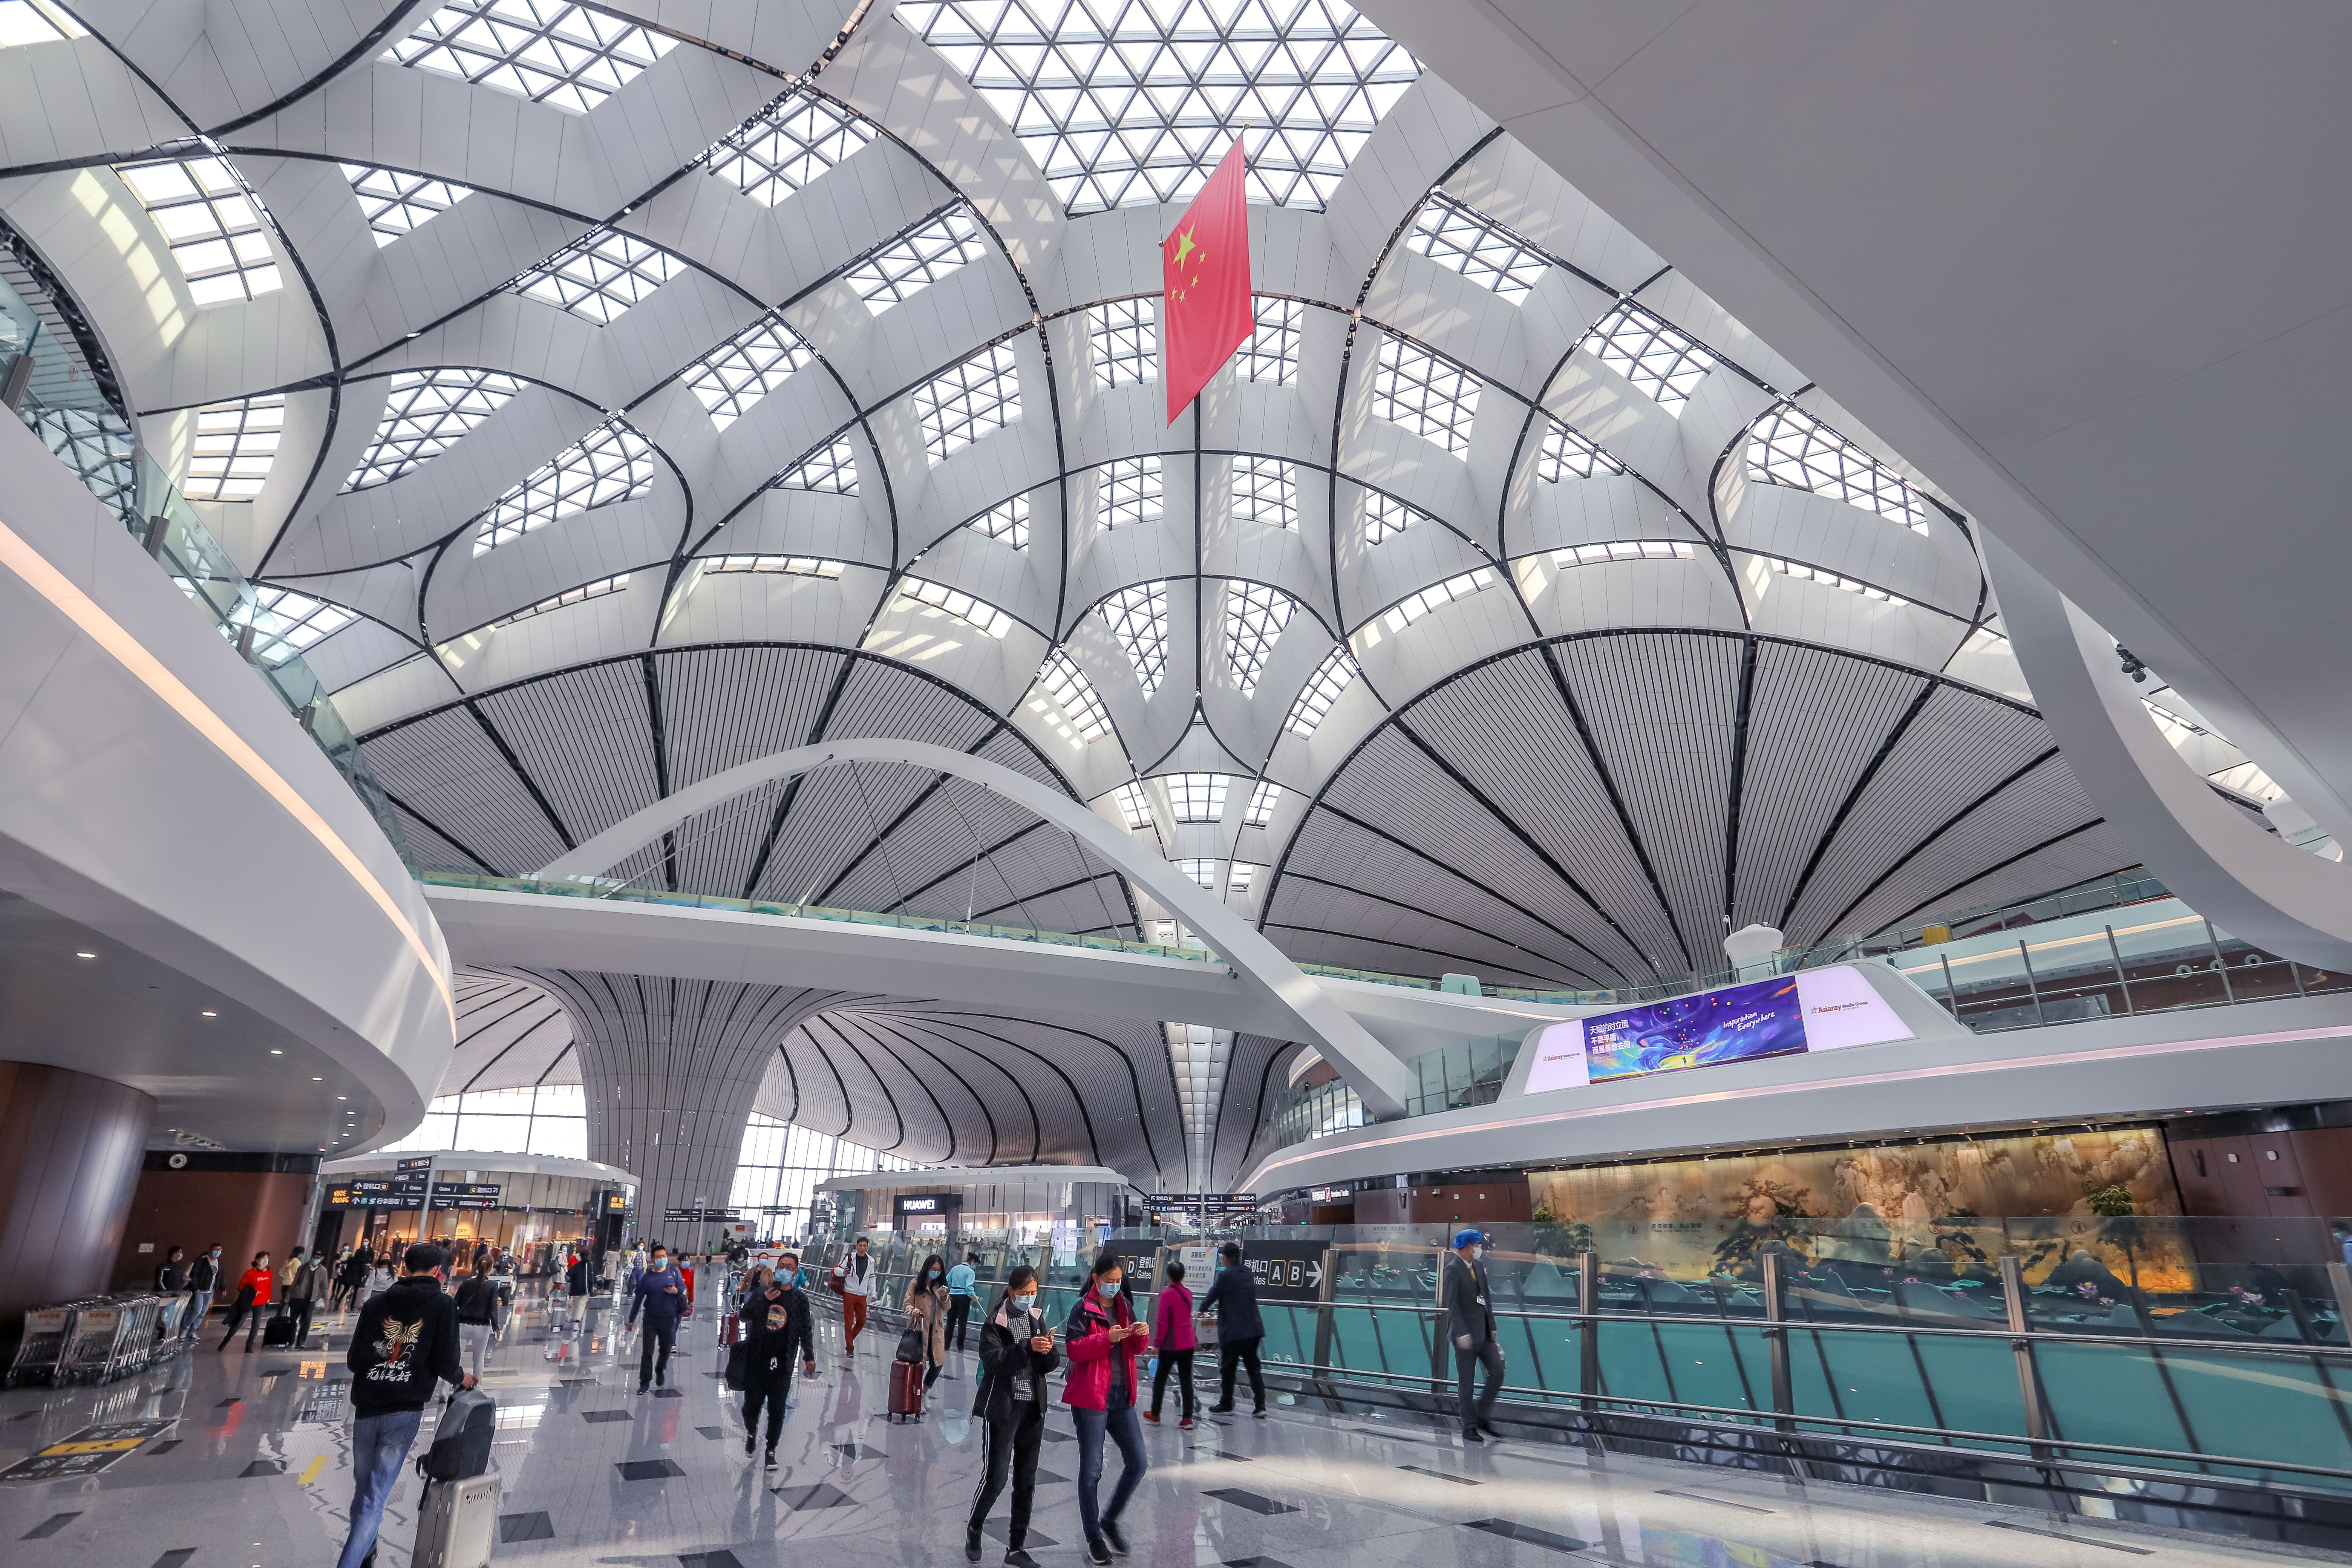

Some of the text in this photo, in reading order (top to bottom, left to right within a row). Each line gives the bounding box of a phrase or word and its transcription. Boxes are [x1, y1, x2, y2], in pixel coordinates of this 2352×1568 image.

[1818, 1005, 1841, 1013] Asiaray
[1589, 1019, 1629, 1035] 天赋的对立面
[1723, 1012, 1757, 1028] Inspiration
[1737, 1012, 1775, 1031] Everywhere
[903, 1199, 935, 1210] HUAWEI
[1127, 1261, 1135, 1273] D
[1272, 1265, 1281, 1280] A
[1291, 1266, 1300, 1281] B
[1137, 1270, 1152, 1279] Gates
